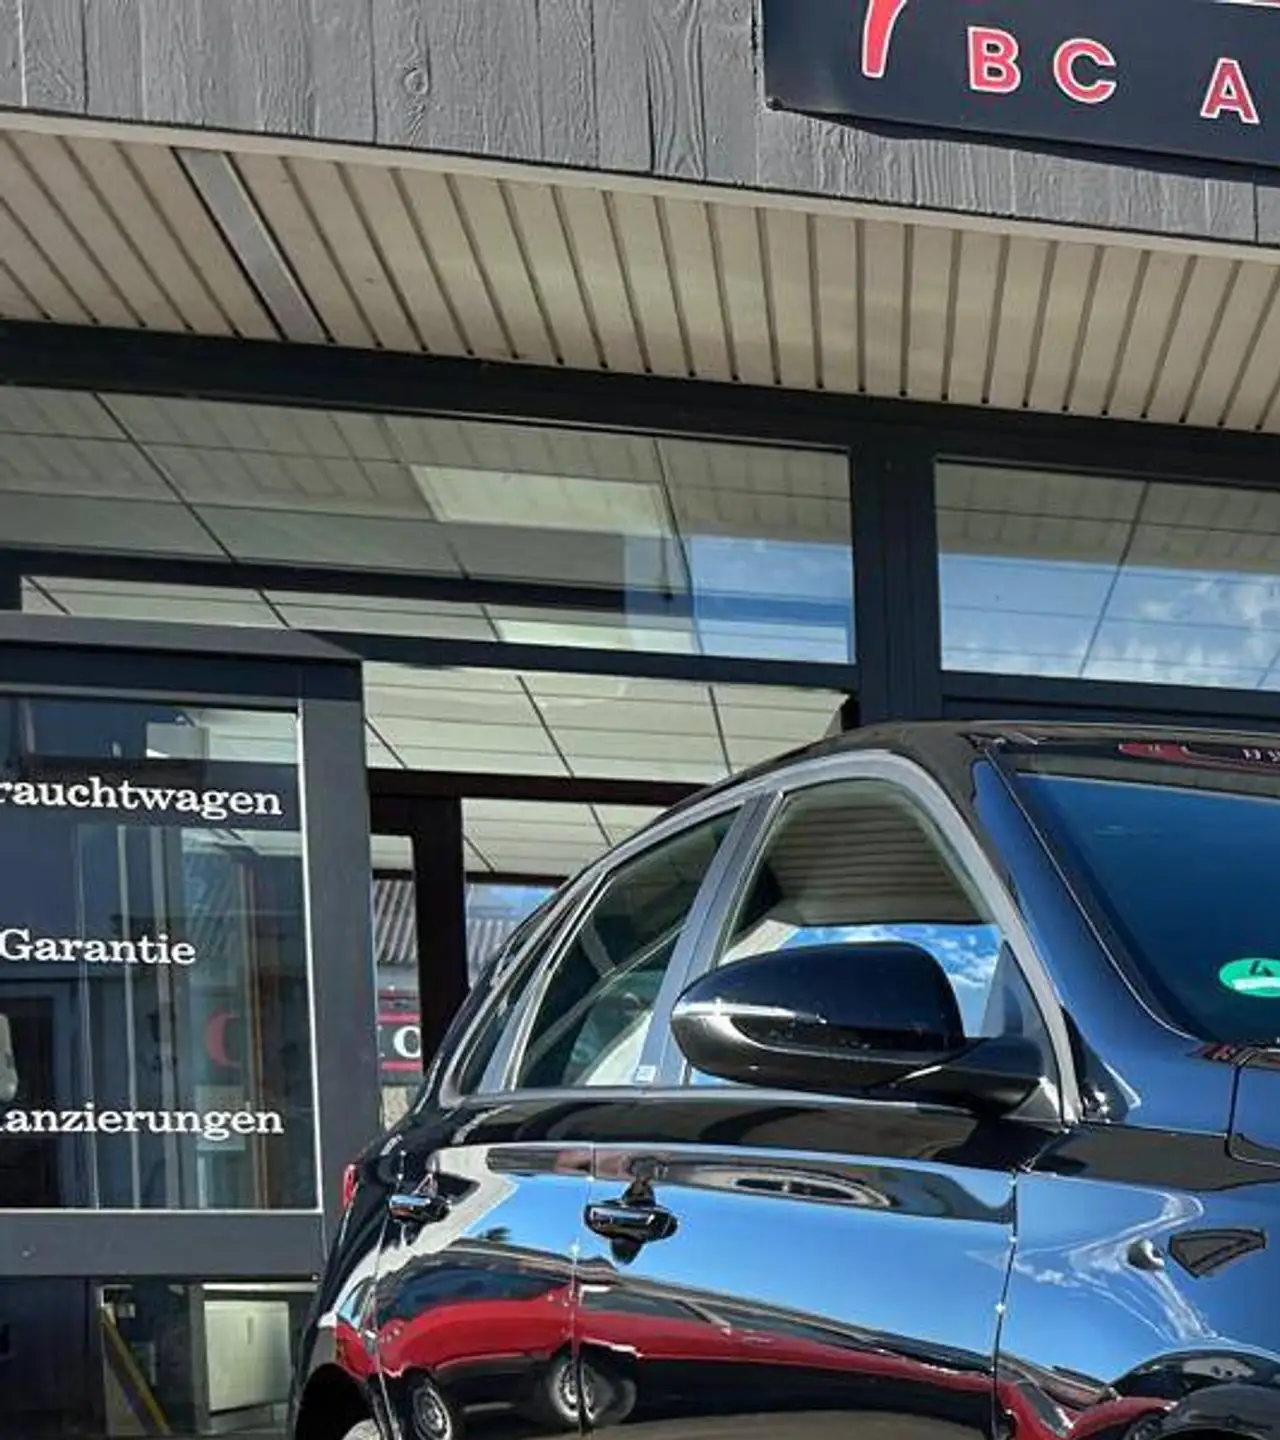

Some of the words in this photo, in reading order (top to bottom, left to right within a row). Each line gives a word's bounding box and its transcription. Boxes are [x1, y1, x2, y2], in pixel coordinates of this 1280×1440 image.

[966, 25, 1117, 103] BC
[0, 928, 196, 965] Garantie
[0, 1103, 284, 1141] anzierungen
